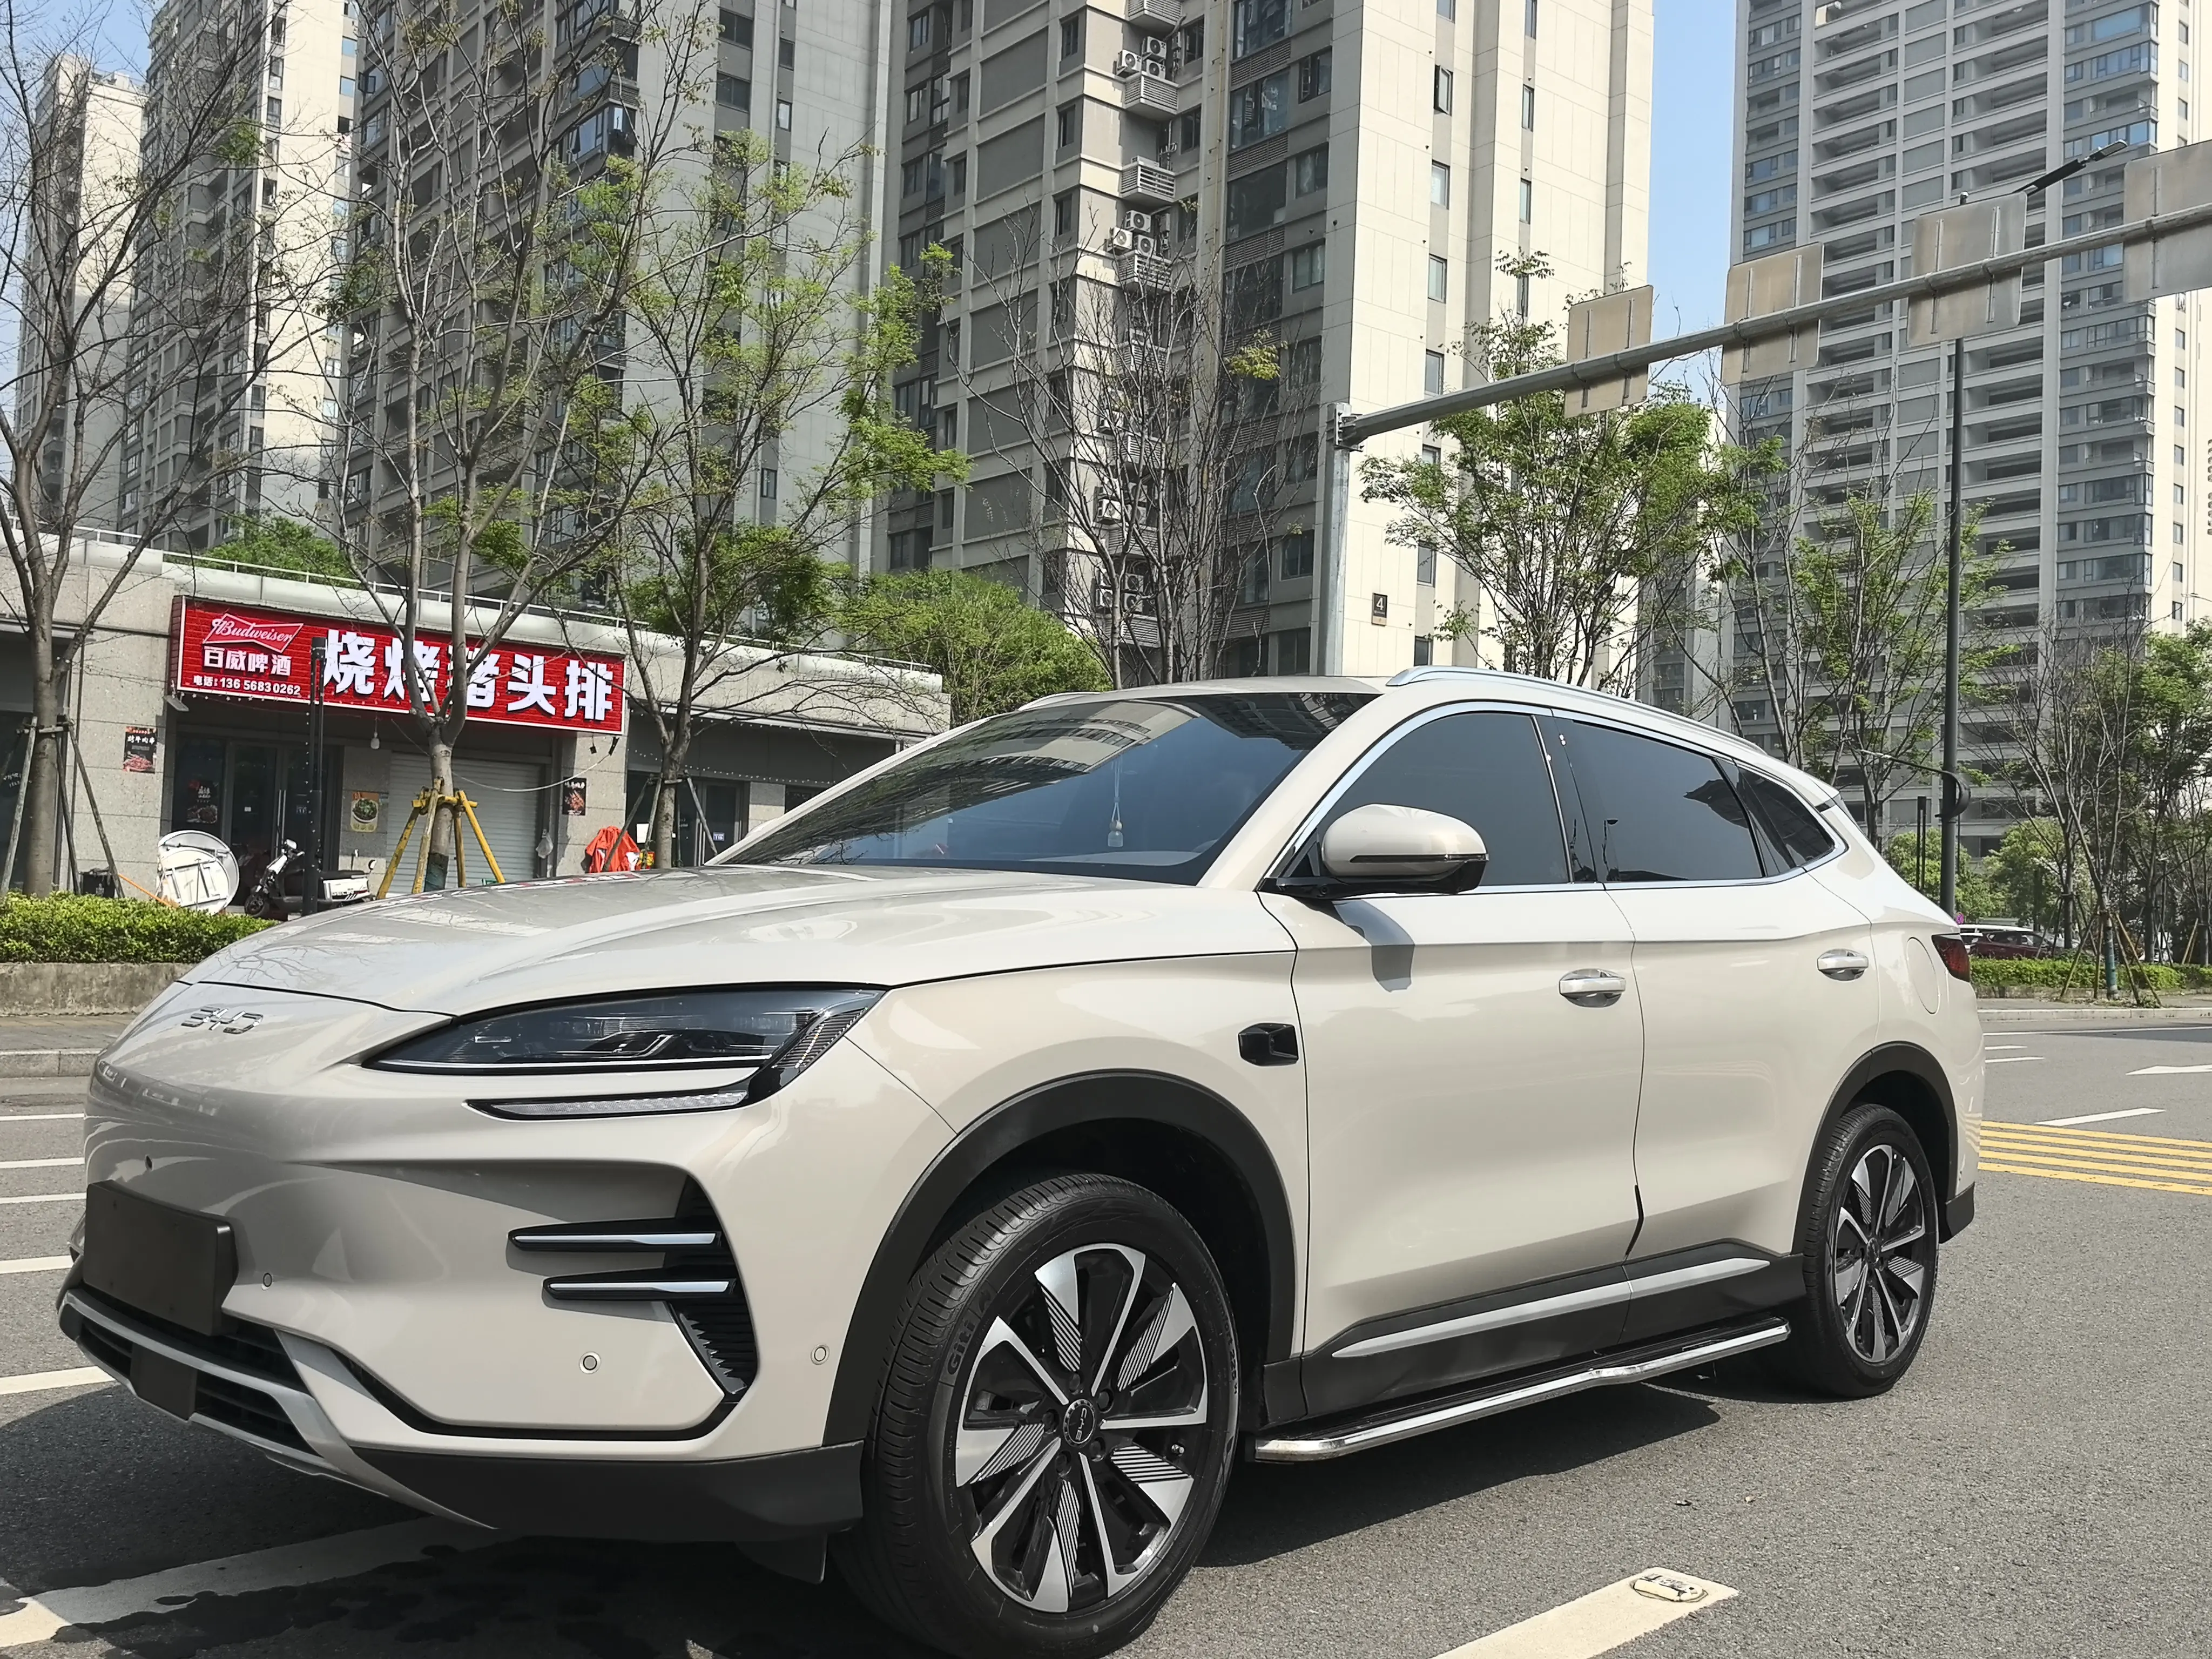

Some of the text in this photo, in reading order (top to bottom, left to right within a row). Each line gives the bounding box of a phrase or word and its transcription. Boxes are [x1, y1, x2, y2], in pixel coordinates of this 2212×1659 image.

[1376, 597, 1384, 610] 4
[212, 618, 294, 642] Budweiser
[204, 645, 292, 676] 百威啤酒
[181, 1006, 264, 1035] BYD
[946, 1320, 975, 1375] Giti
[1075, 1407, 1087, 1441] BYD
